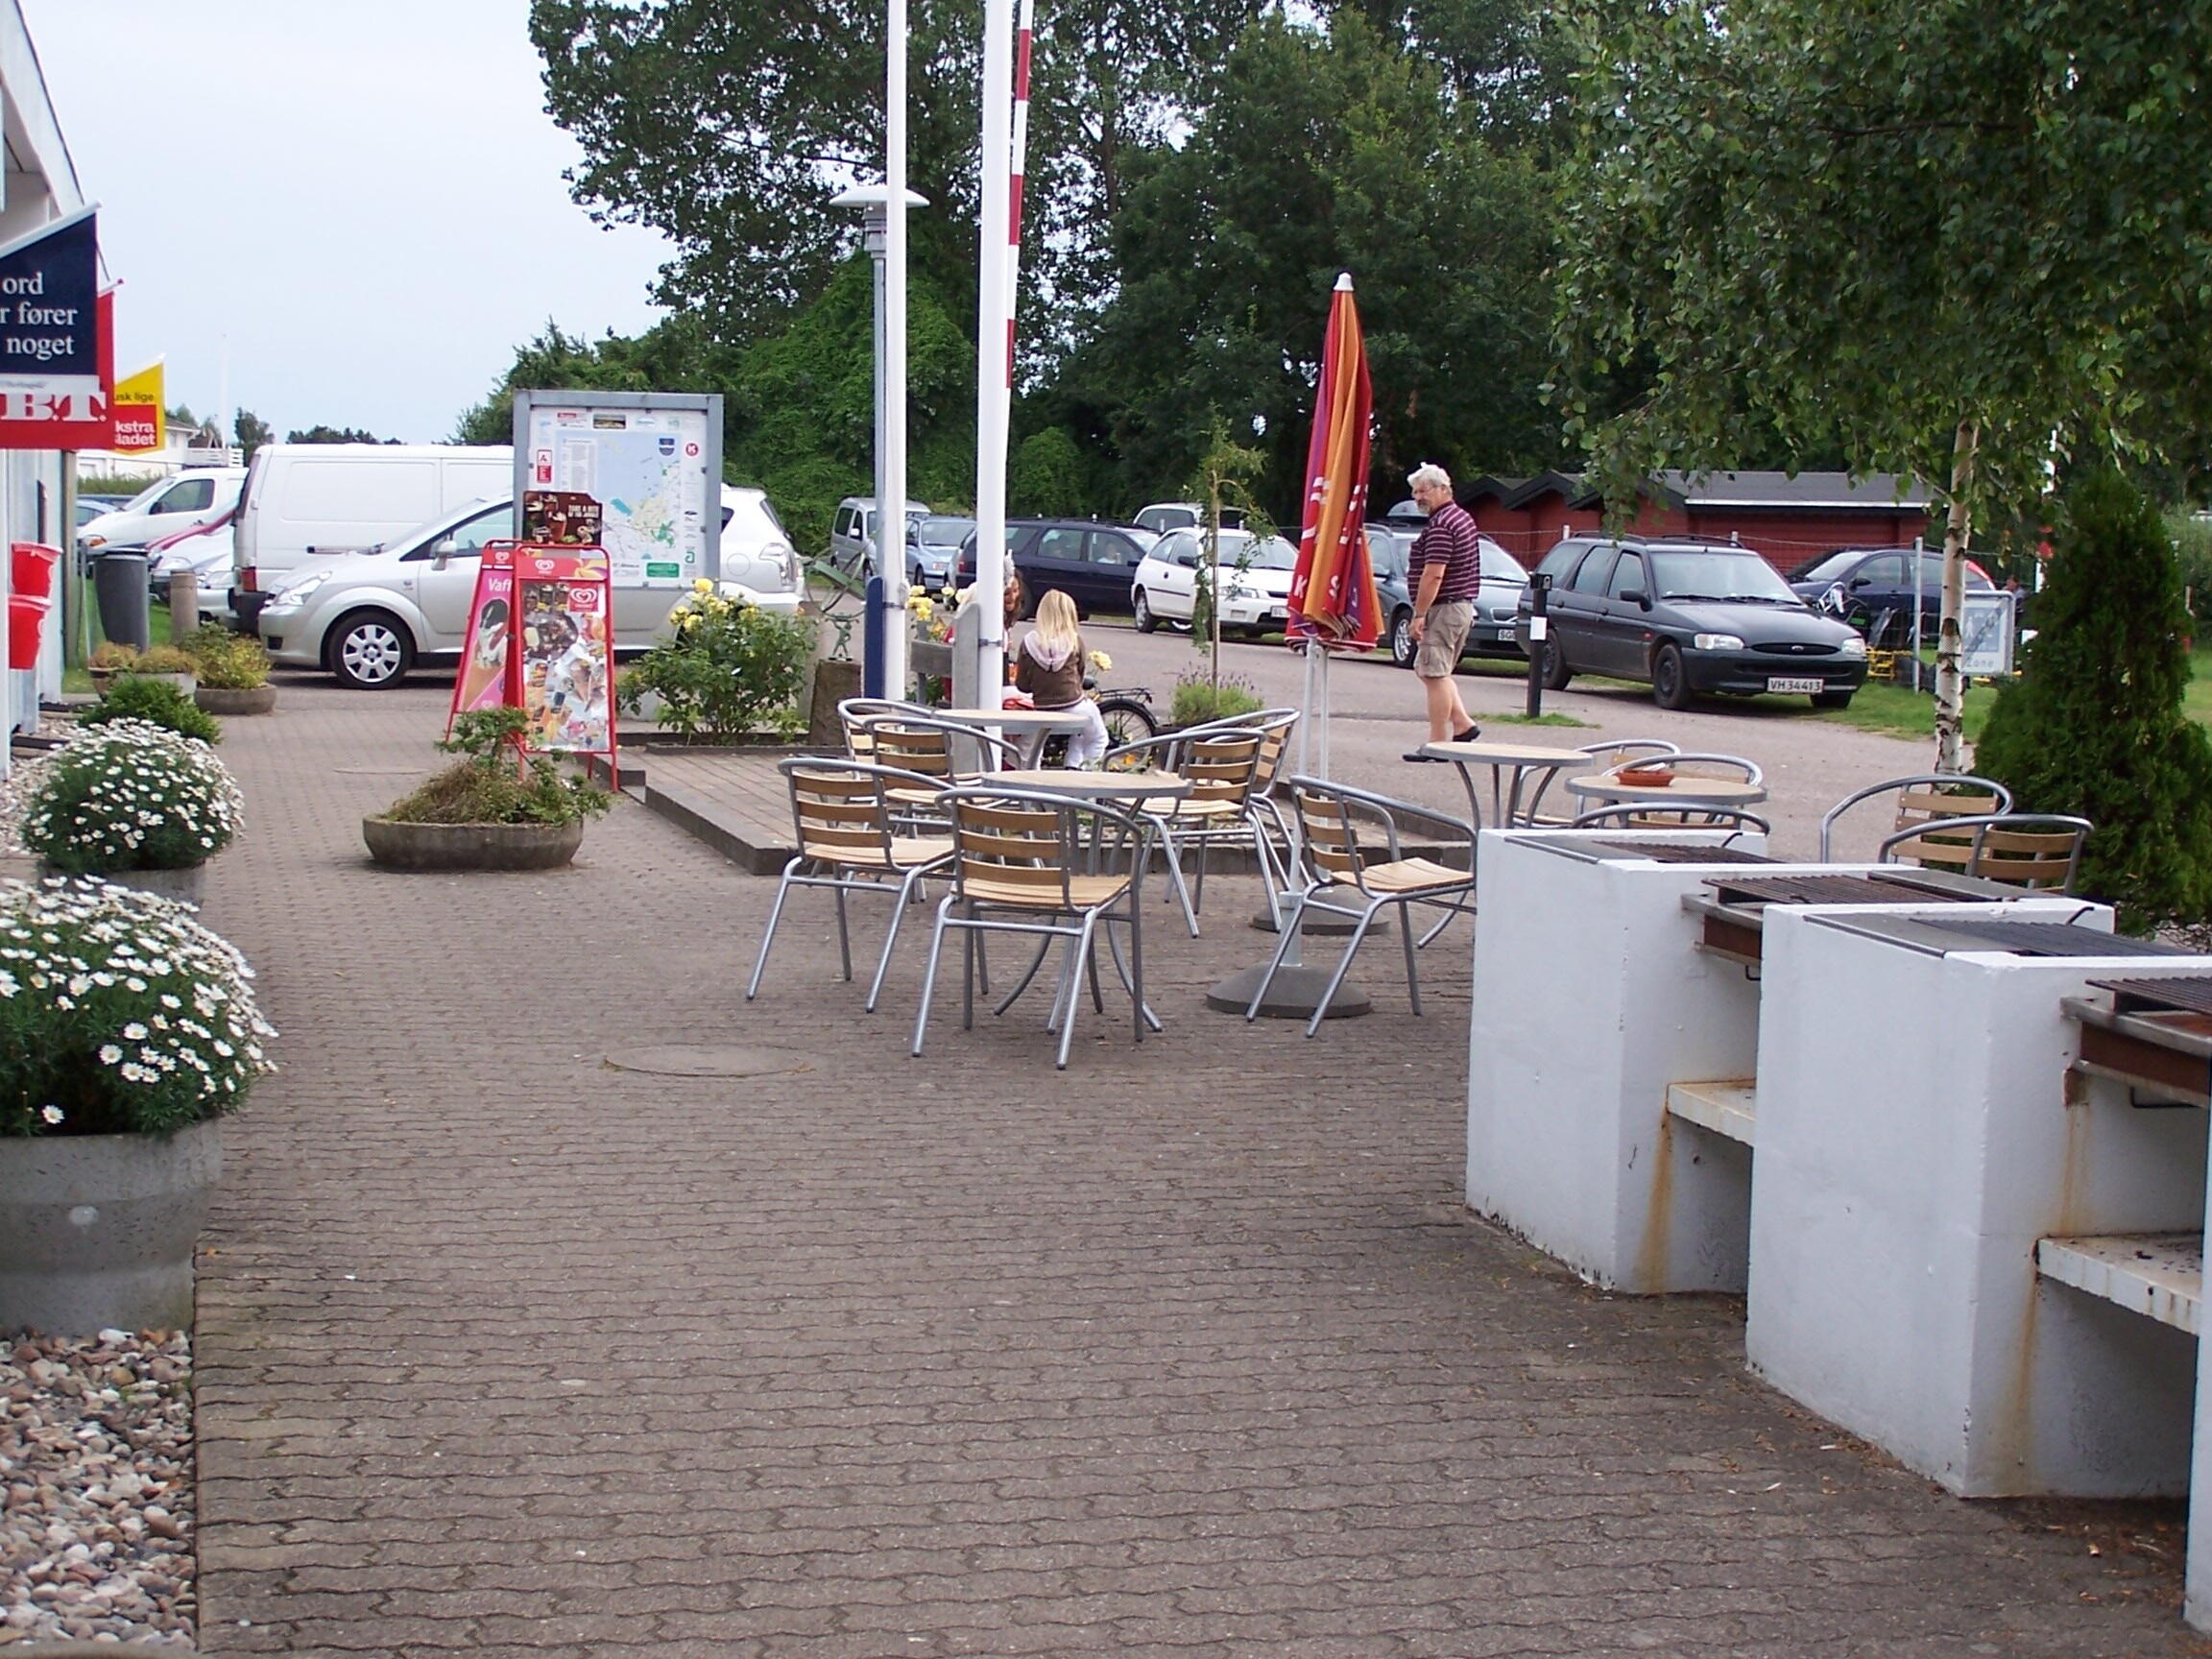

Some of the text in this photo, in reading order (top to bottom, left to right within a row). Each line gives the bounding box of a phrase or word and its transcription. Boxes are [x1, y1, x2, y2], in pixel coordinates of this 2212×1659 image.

[2, 271, 44, 296] ord
[17, 301, 78, 325] fører
[7, 336, 75, 361] noget
